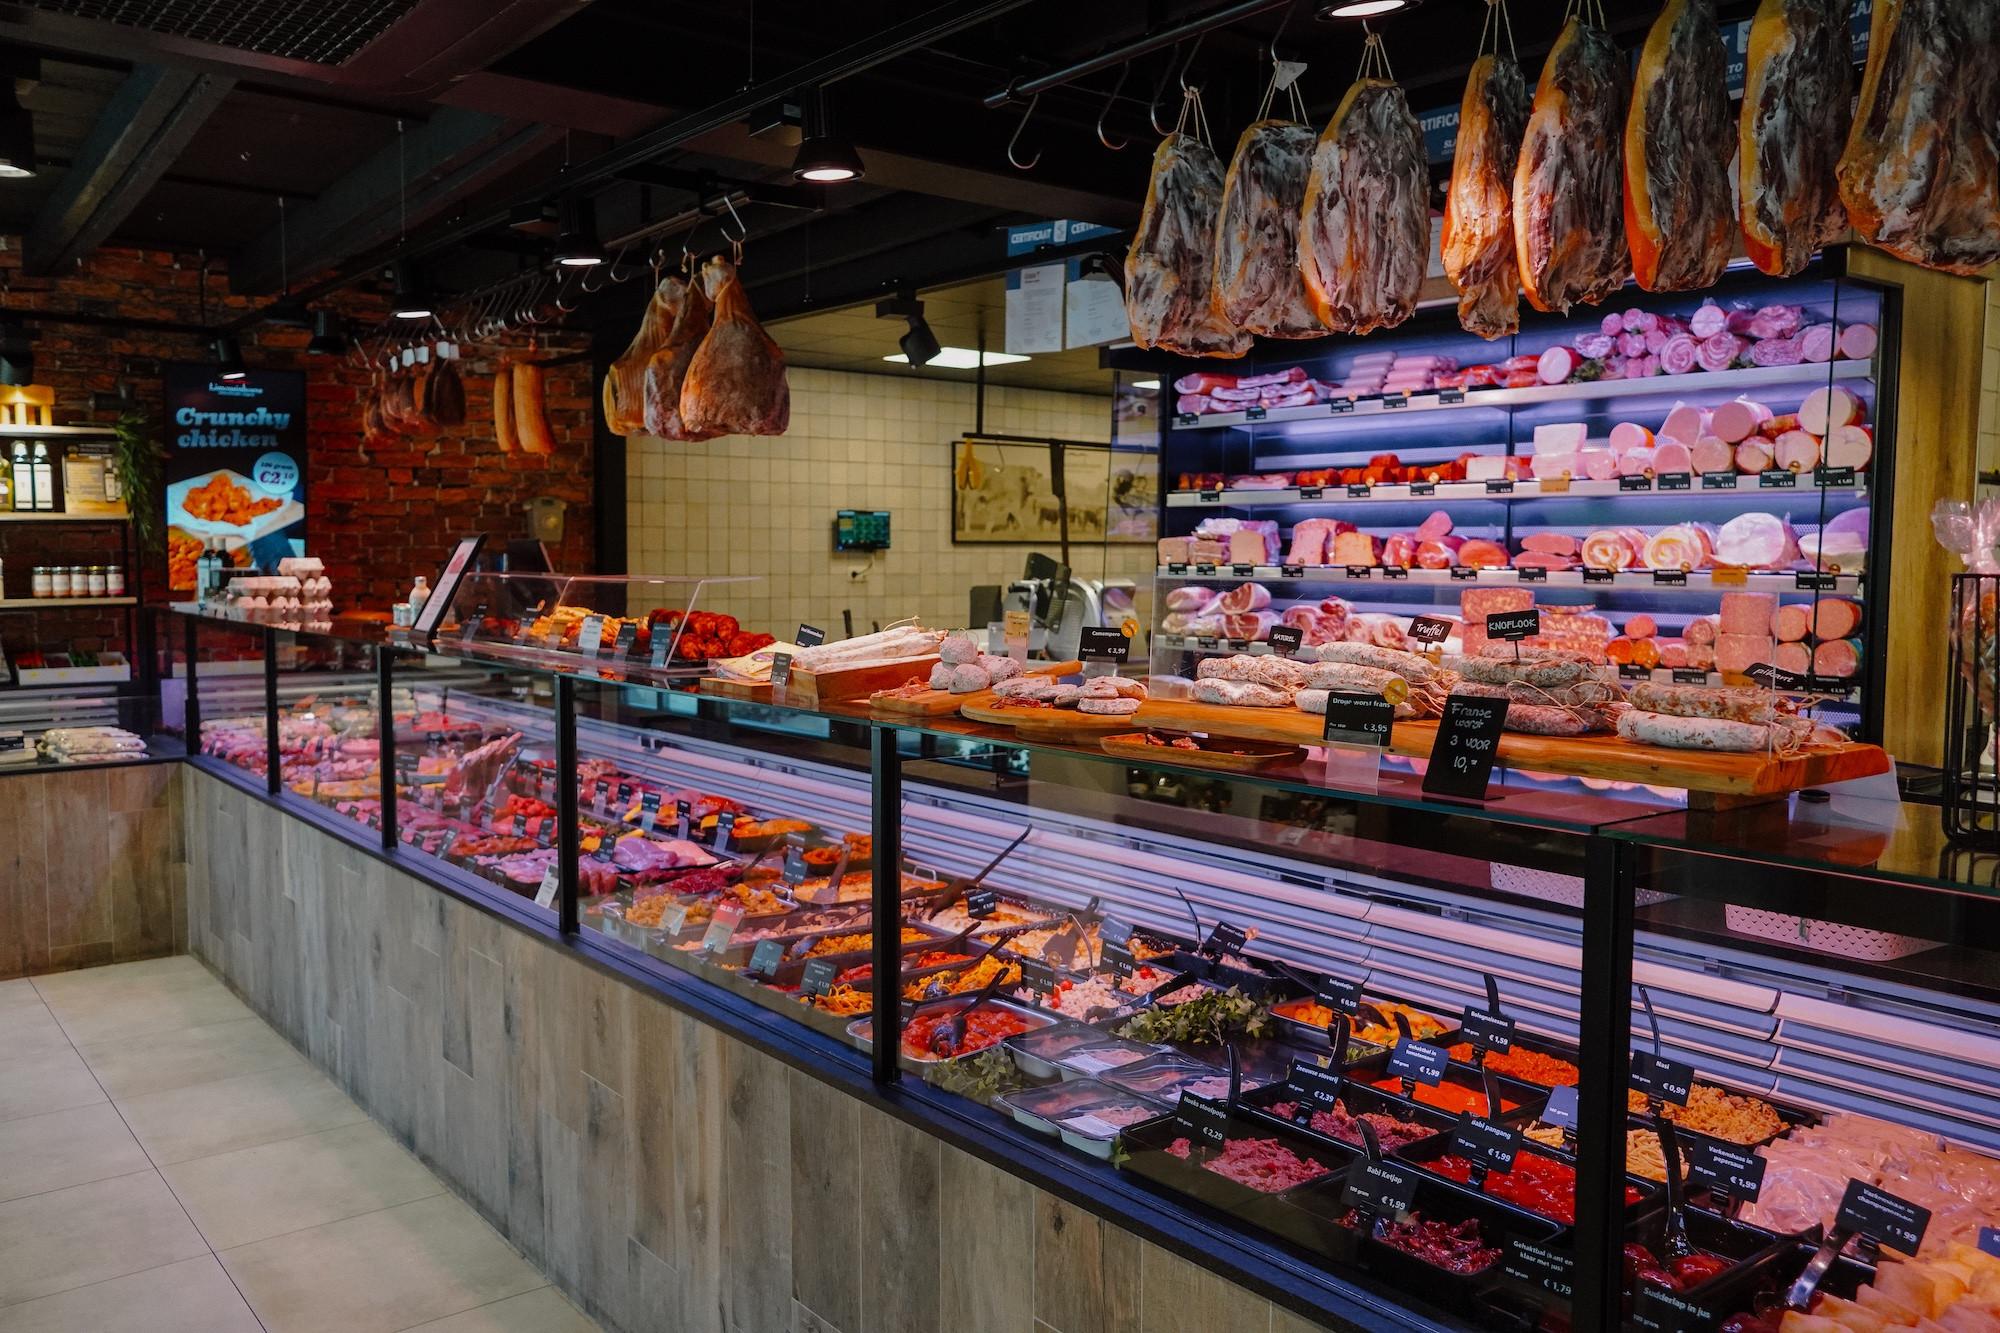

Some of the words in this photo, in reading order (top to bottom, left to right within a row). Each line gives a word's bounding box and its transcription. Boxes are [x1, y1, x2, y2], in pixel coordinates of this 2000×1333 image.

[176, 406, 291, 429] Crunchy
[177, 429, 279, 448] chicken
[1416, 623, 1444, 637] Truffel
[1488, 618, 1537, 631] KNOFLOOK
[1451, 703, 1492, 719] Franse
[1370, 723, 1388, 732] 3,95
[1450, 735, 1458, 746] 3
[1494, 1036, 1508, 1045] 1,59
[1655, 1060, 1670, 1070] Nasi
[1425, 1067, 1440, 1077] 1,99
[1669, 1085, 1686, 1096] 0,99
[1319, 1092, 1334, 1103] 2,39
[1207, 1128, 1223, 1140] 2,29
[1484, 1125, 1512, 1140] pangang
[1495, 1150, 1511, 1162] 1,99
[1708, 1145, 1746, 1163] Varkenshaas
[1746, 1157, 1753, 1165] in
[1366, 1165, 1382, 1176] Babi
[1381, 1171, 1403, 1184] Ketjap
[1738, 1178, 1757, 1190] 1,99
[1389, 1198, 1406, 1210] 1,99
[1895, 1227, 1917, 1243] 199
[1513, 1240, 1546, 1257] Gehaktbal
[1564, 1259, 1574, 1267] en
[1519, 1251, 1537, 1262] klaar
[1536, 1259, 1550, 1267] met
[1553, 1281, 1572, 1295] 1,79
[1643, 1286, 1686, 1310] Sudderlap
[1687, 1302, 1697, 1313] in
[1696, 1306, 1711, 1319] jus
